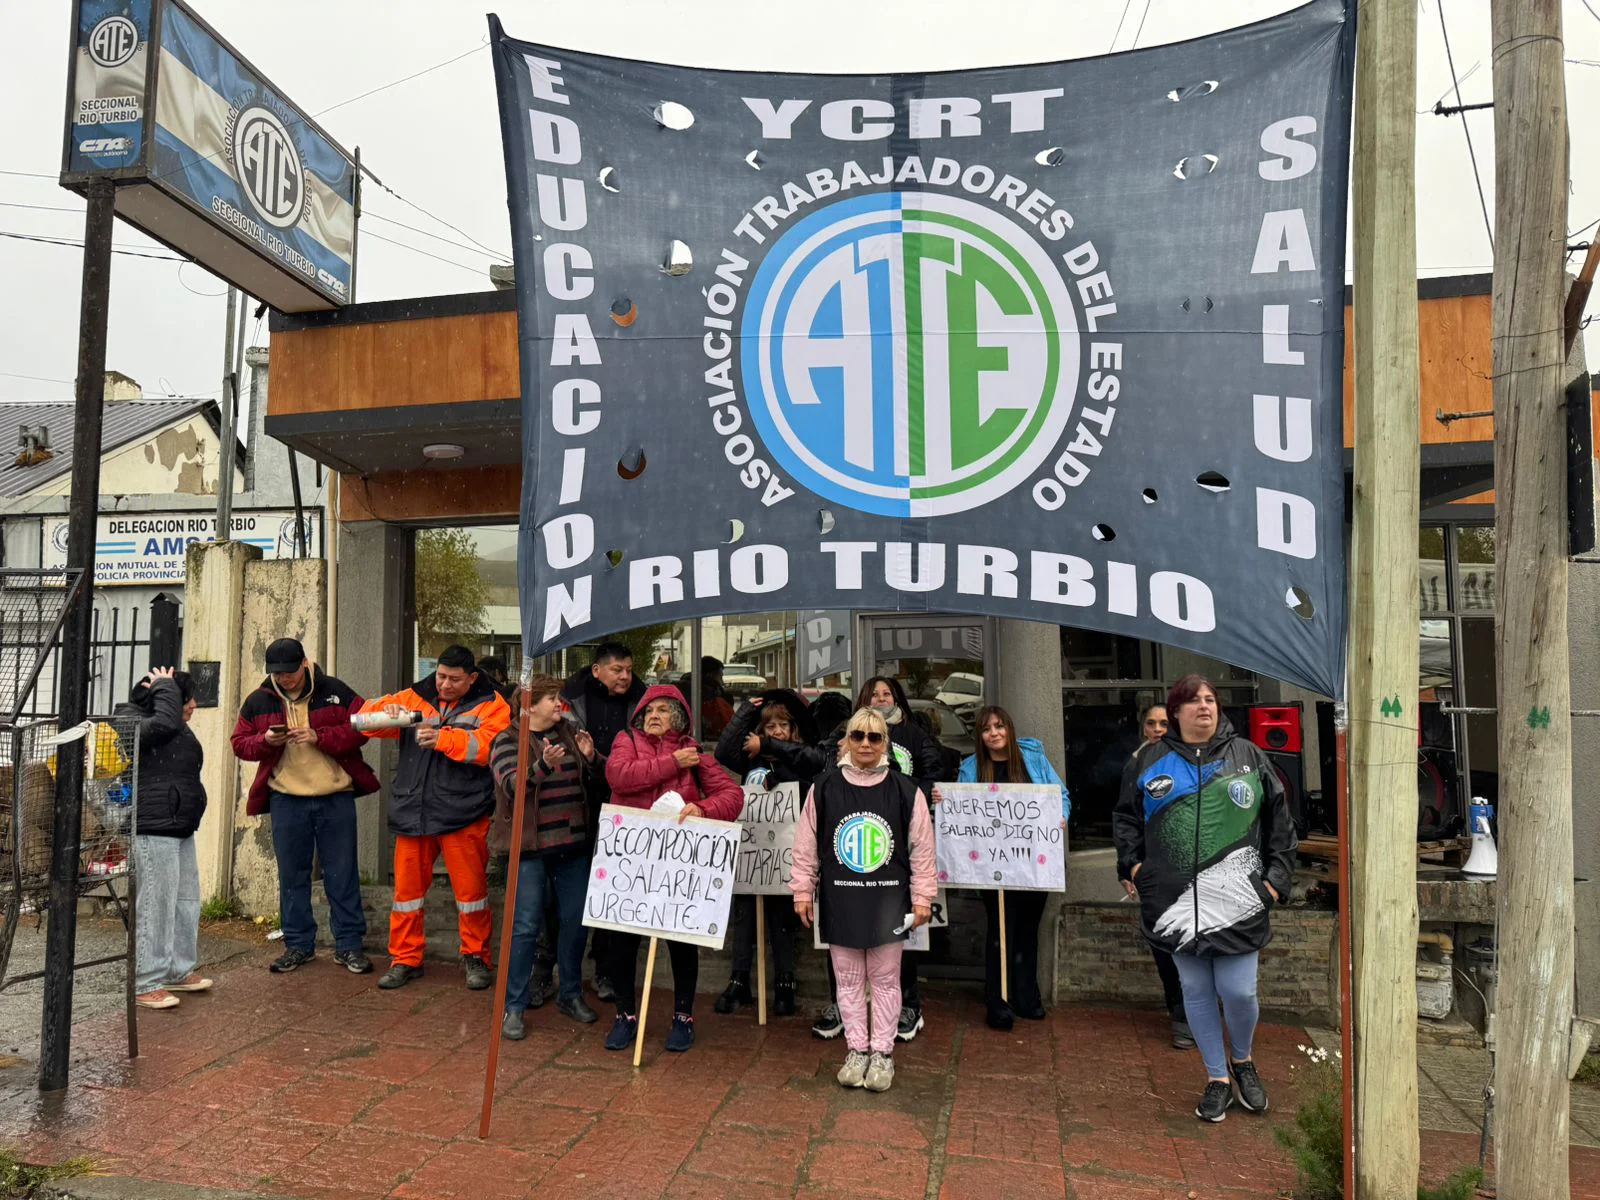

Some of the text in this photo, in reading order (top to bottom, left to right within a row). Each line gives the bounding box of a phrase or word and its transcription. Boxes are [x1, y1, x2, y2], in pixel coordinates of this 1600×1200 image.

[94, 21, 133, 61] ATE
[79, 110, 138, 124] RIO TURBIO
[81, 97, 137, 111] SECCIONAL
[741, 88, 1064, 141] YCRT
[243, 120, 297, 215] ATE
[212, 196, 316, 278] SECCIONAL RIO TURBIO
[523, 54, 602, 643] EDUCACION
[702, 155, 1123, 511] ASOCIACIÓN TRABAJADORES DEL ESTADO
[1250, 115, 1317, 559] SALUD
[781, 231, 1036, 477] ATE
[109, 517, 256, 534] DELEGACION RIO TRBIO
[143, 536, 215, 556] AM
[118, 561, 159, 570] MUTUAL
[164, 560, 177, 569] DE
[629, 541, 1216, 632] RIO TURBIO
[941, 798, 1042, 821] QUEREMOS
[844, 825, 883, 866] ATE
[940, 821, 1060, 844] SALARIO DIGNO
